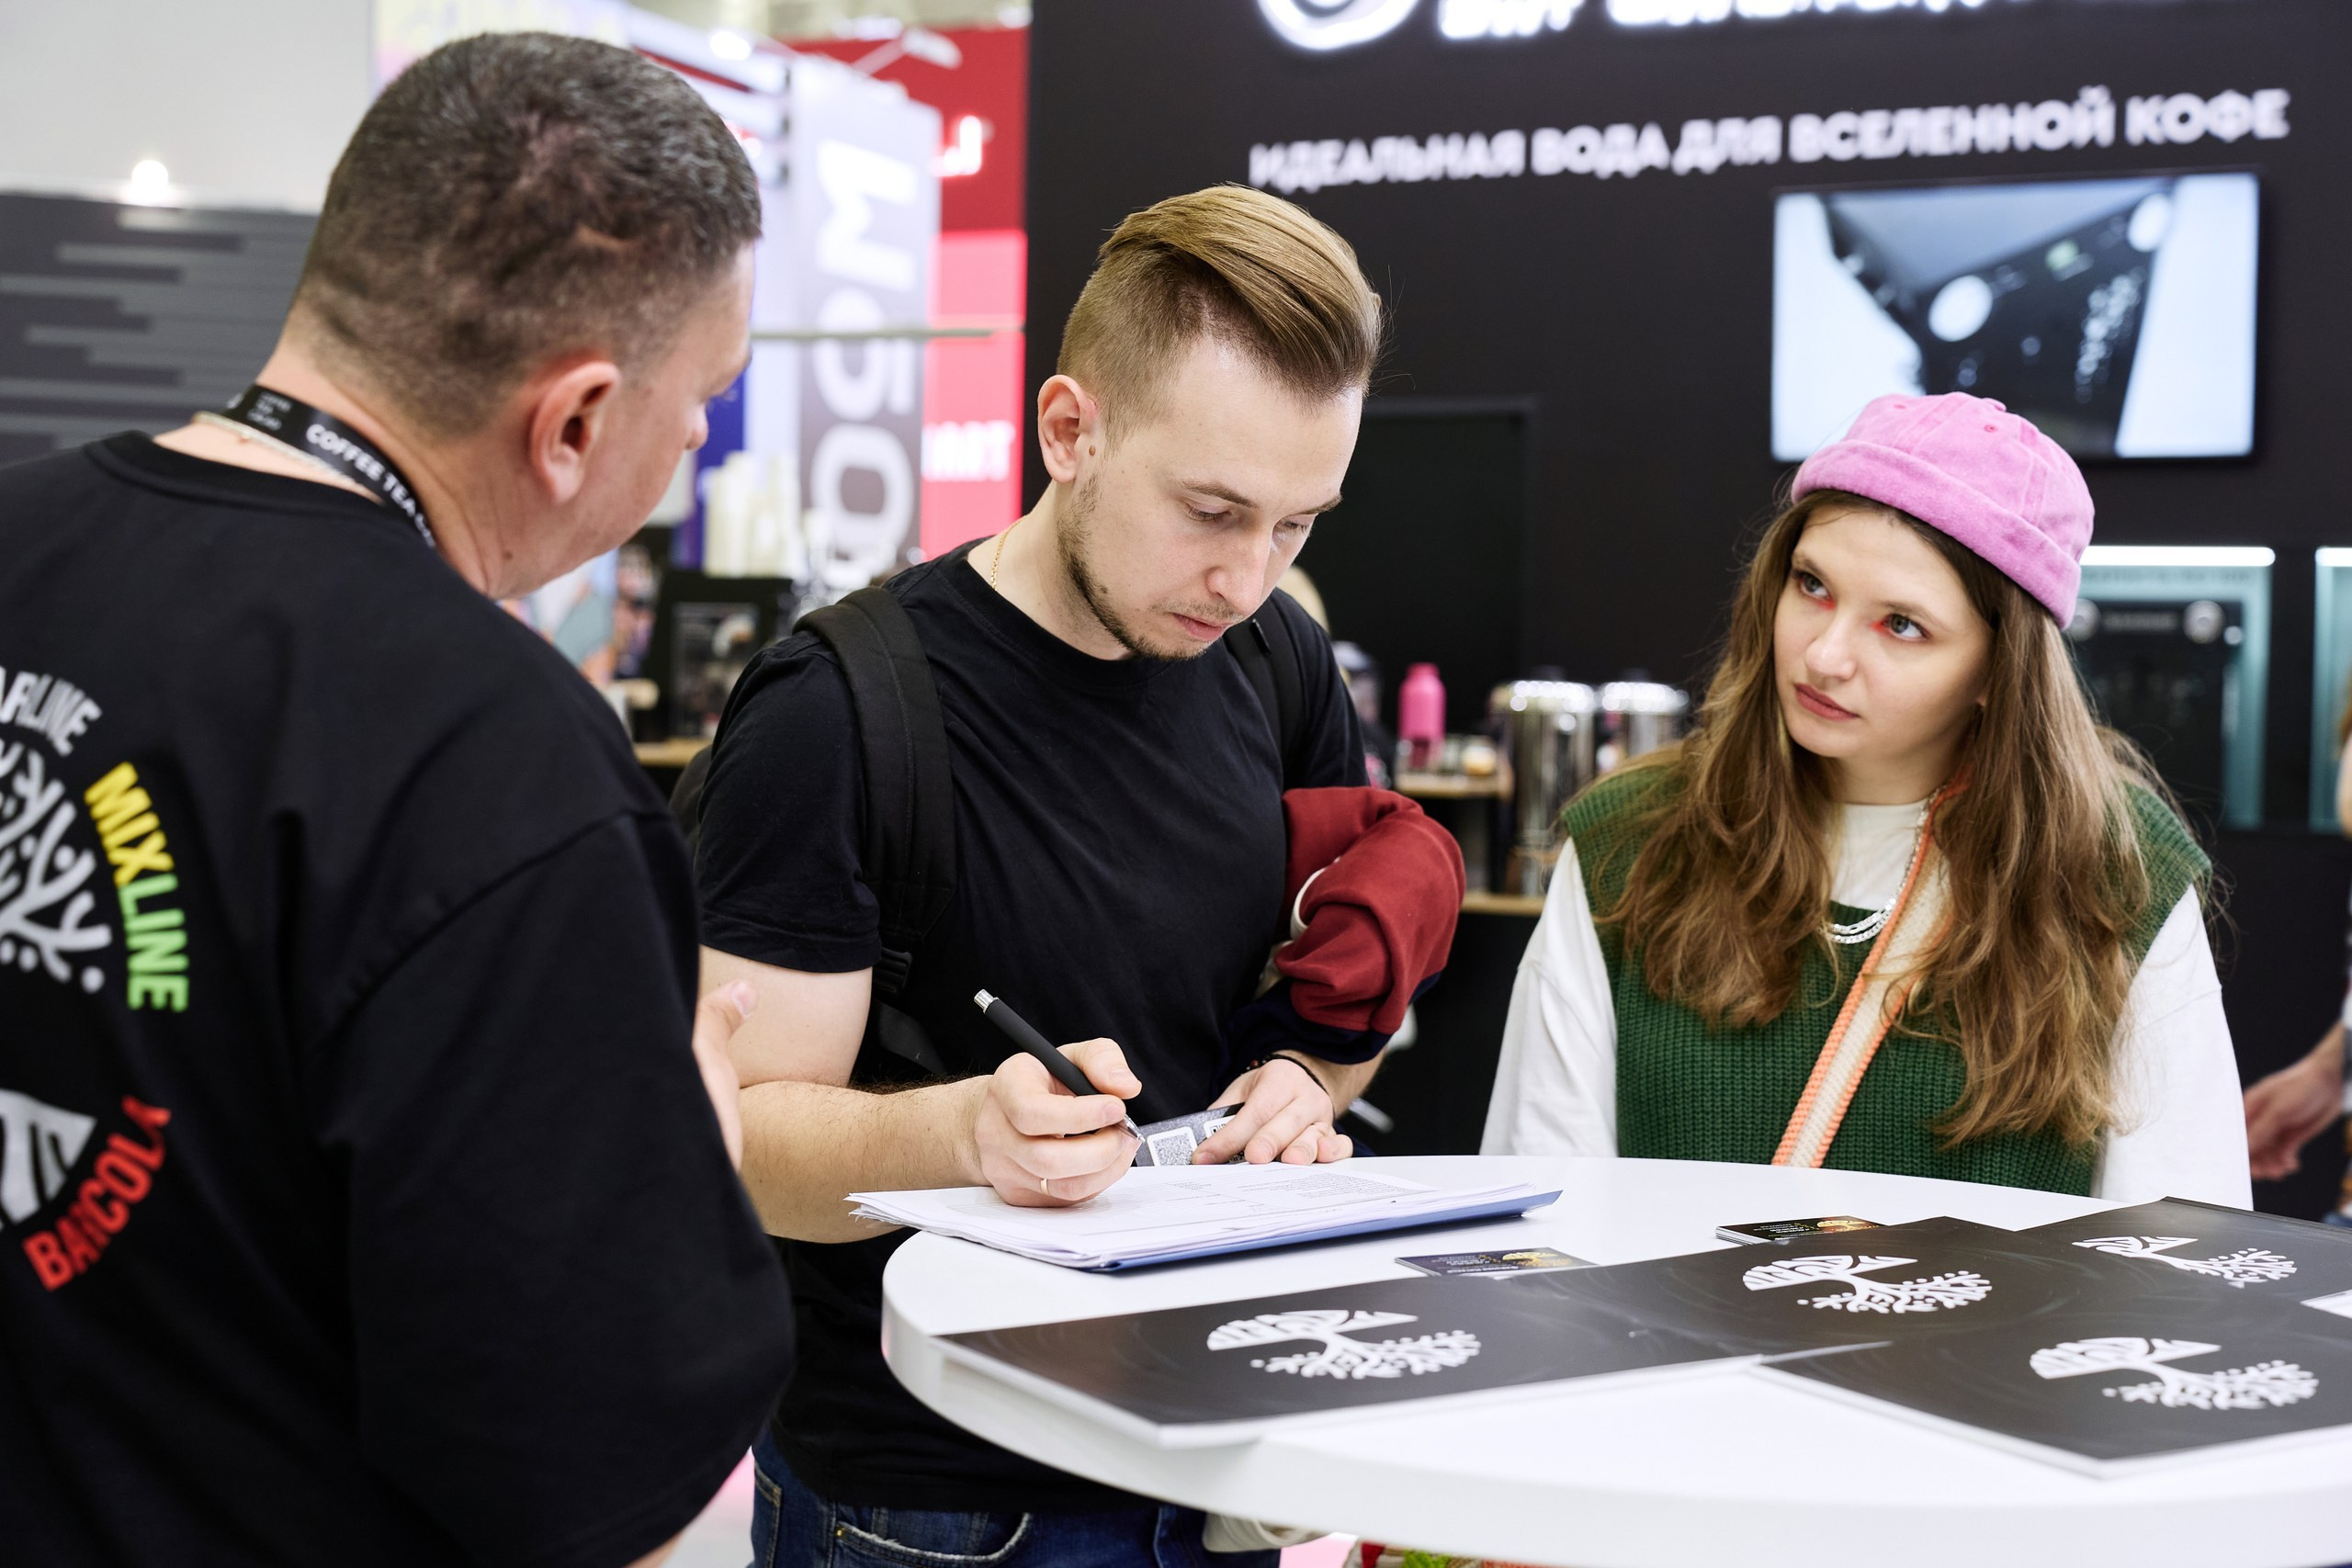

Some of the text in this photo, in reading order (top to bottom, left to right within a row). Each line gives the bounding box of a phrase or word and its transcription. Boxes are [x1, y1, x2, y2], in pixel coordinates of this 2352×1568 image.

[1250, 85, 2290, 191] ИДЕАЛЬНАЯ ВОДА ДЛЯ ВСЕЛЕННОЙ КОФЕ
[306, 423, 386, 481] COFFEE
[382, 472, 415, 517] TEA
